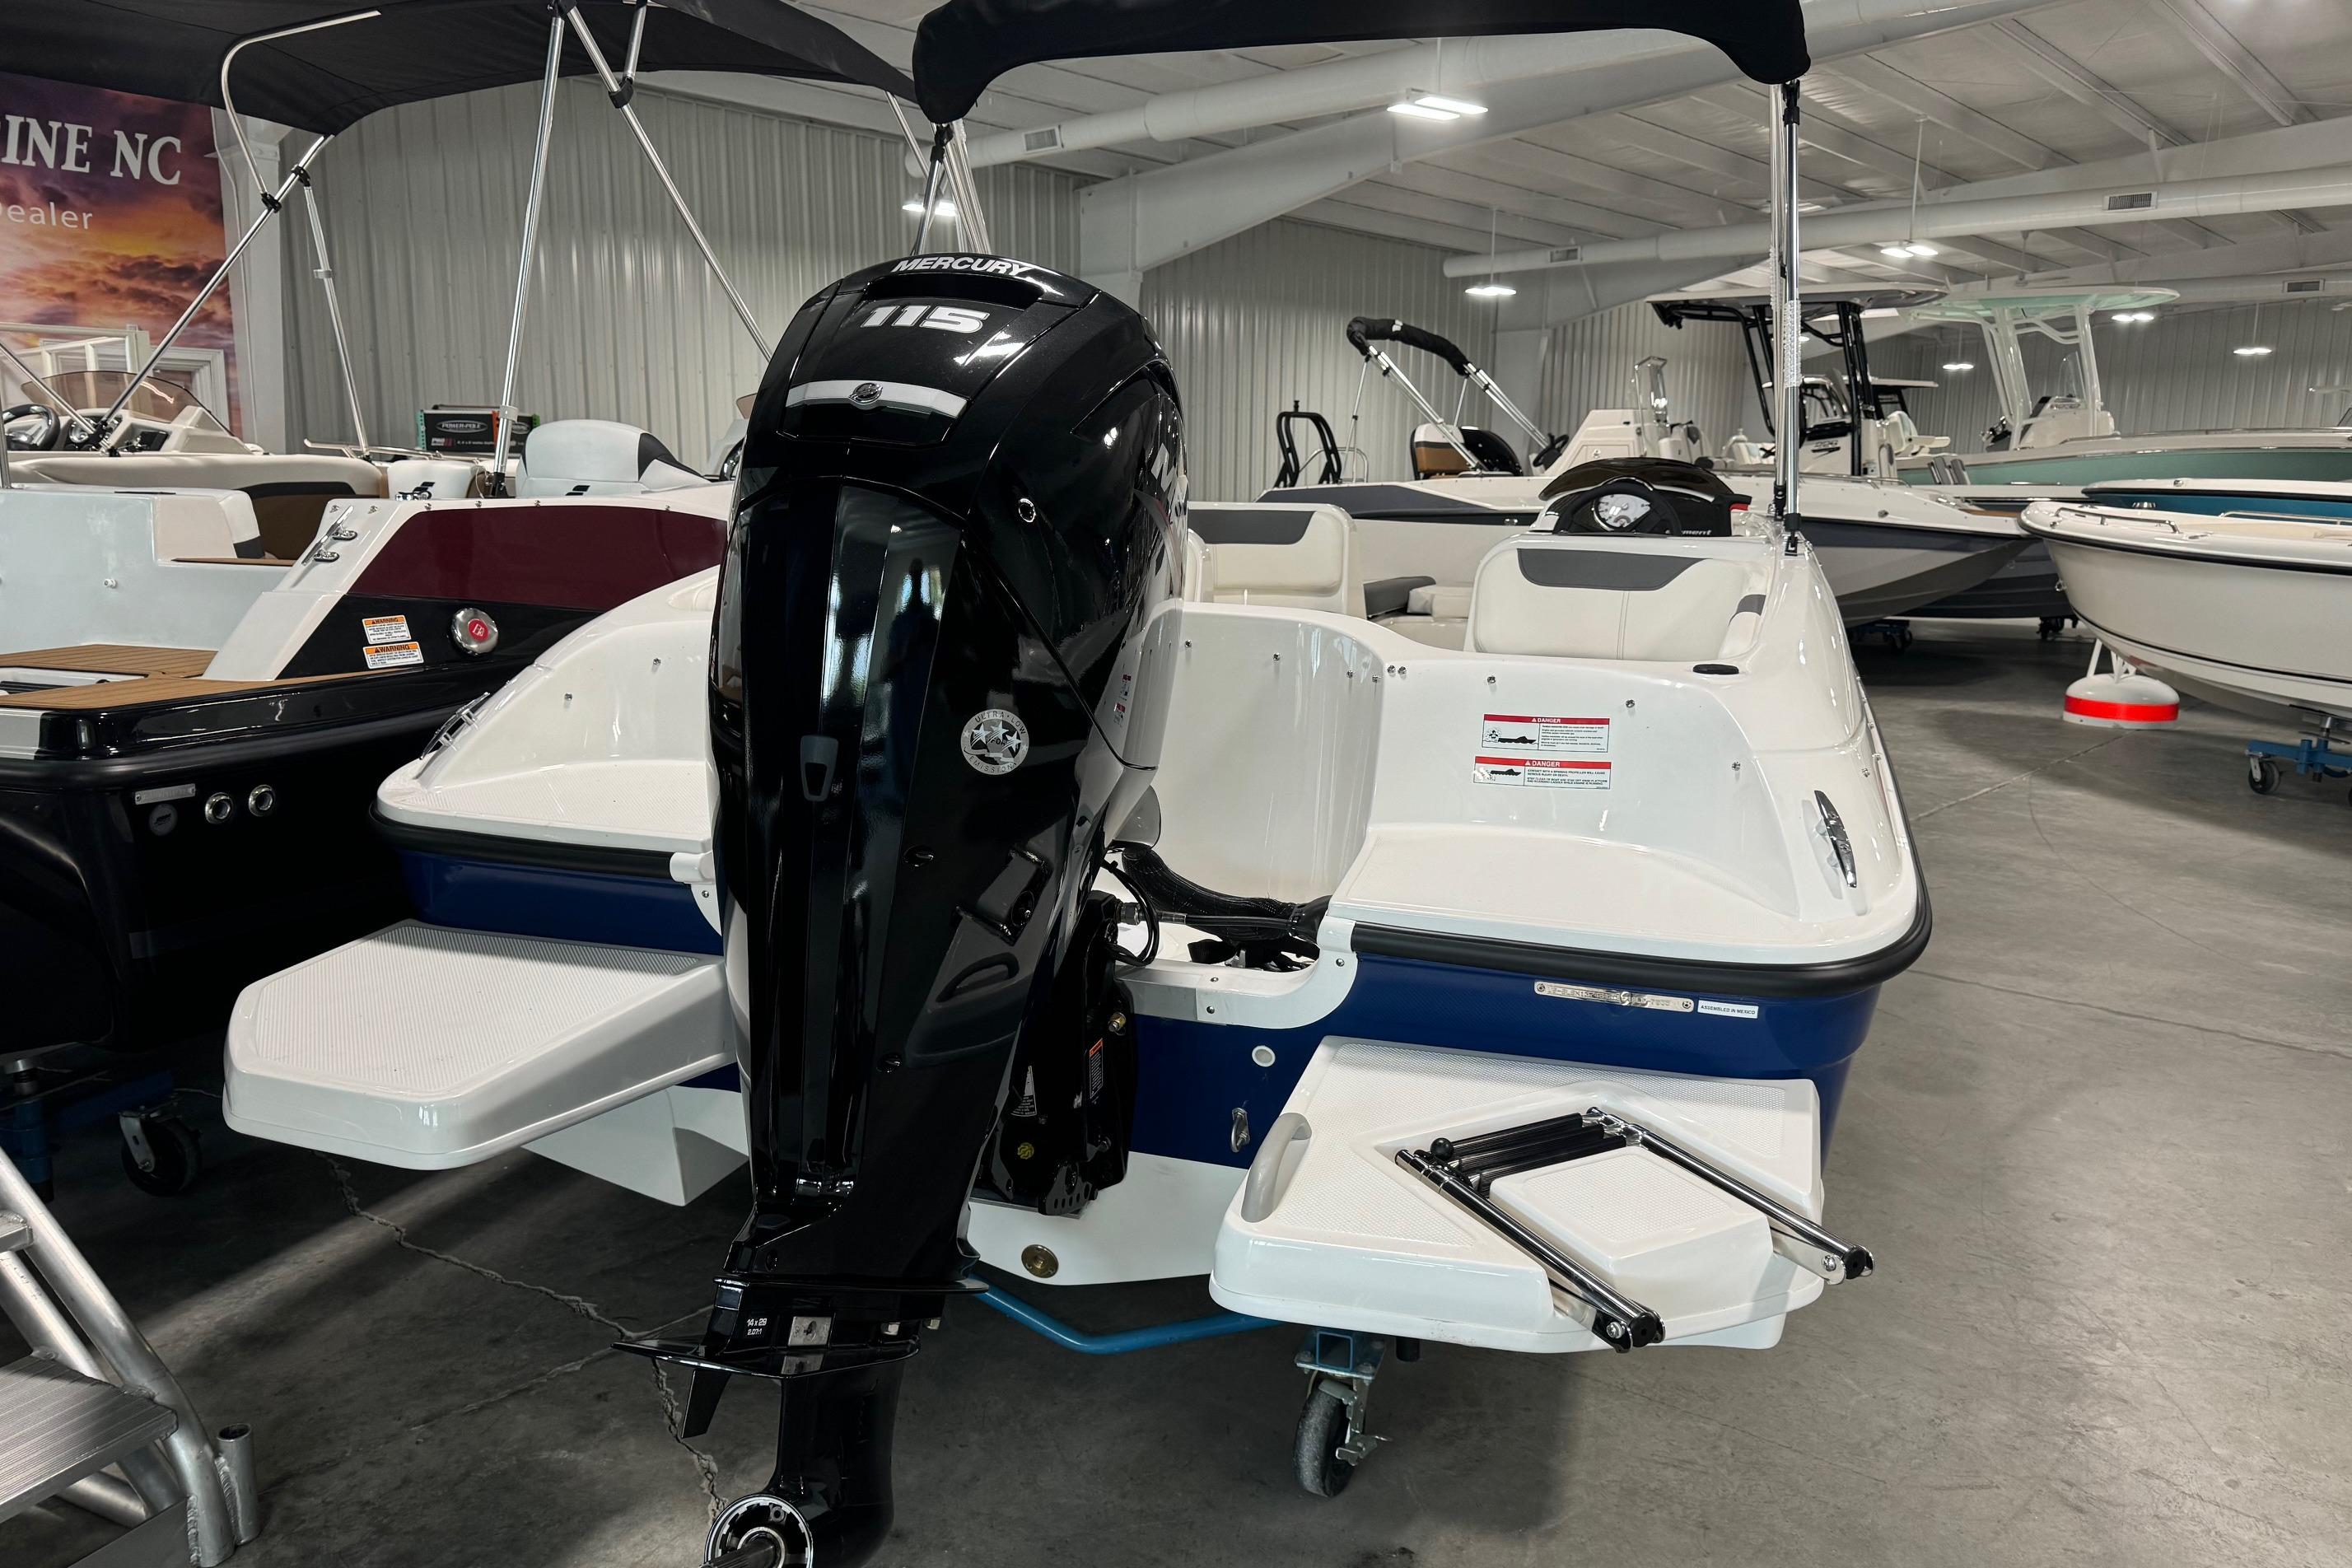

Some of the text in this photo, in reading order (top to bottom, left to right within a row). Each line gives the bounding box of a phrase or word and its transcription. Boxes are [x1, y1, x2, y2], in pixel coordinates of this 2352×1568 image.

[0, 114, 181, 185] INE NC
[0, 201, 93, 230] ealer
[890, 256, 1033, 276] MERCURY
[861, 305, 990, 334] 115
[380, 645, 410, 653] WARNING
[974, 711, 1026, 735] ULTRA LOW
[747, 1318, 754, 1327] 14
